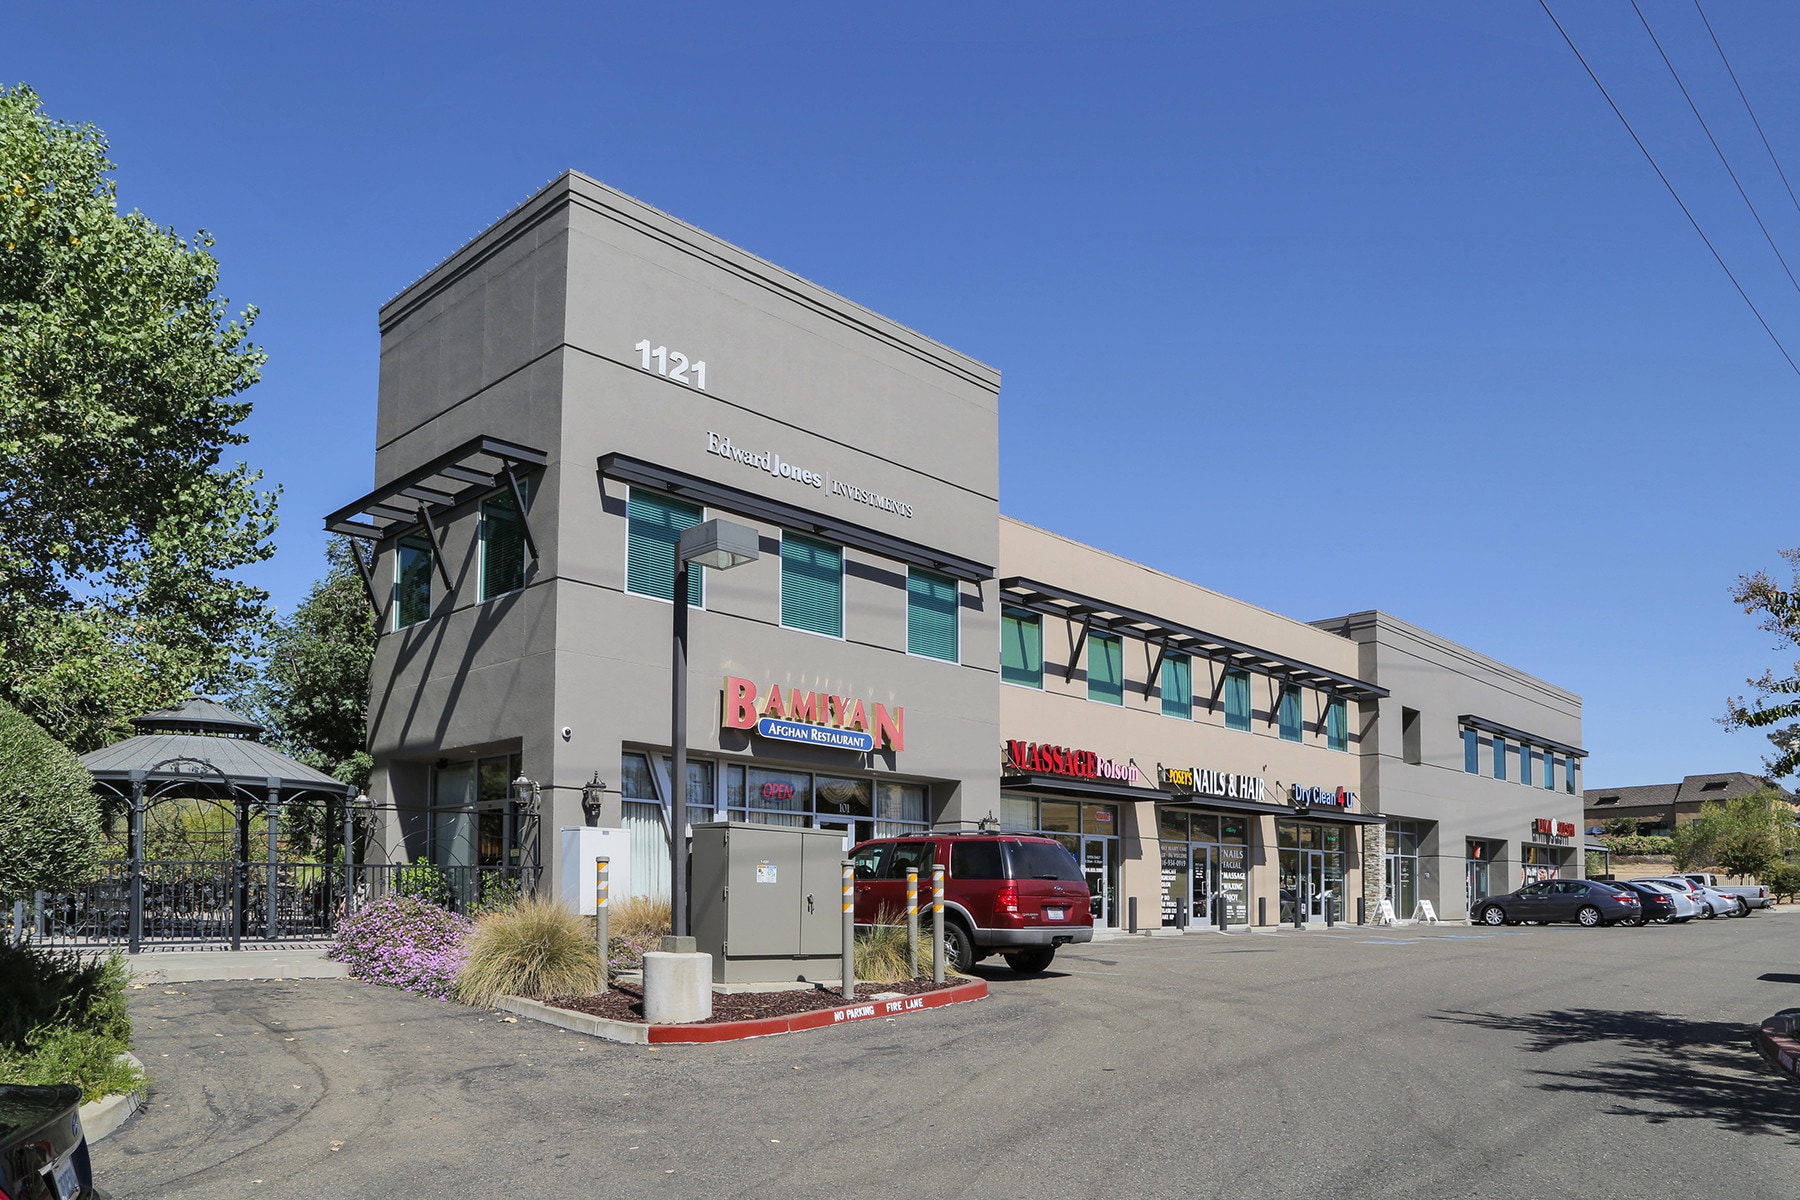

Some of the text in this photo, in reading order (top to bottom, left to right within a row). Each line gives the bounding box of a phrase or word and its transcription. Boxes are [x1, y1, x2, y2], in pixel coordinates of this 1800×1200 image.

[635, 339, 706, 391] 1121
[832, 480, 913, 518] INVESTMENTS
[724, 676, 904, 752] BAMIYAN
[768, 722, 865, 748] AFGHAN RESTAURANT
[1008, 740, 1139, 782] MASSAGE Folsom
[762, 781, 794, 800] OPEN
[1169, 767, 1265, 801] POSEY'S NAILS & HAIR
[1295, 783, 1354, 808] Dry Clean 4 U
[838, 803, 850, 814] 101
[1223, 849, 1244, 859] NAILS
[1223, 861, 1242, 869] FACIAL
[1223, 872, 1246, 880] MASSAGE
[1223, 882, 1243, 891] WAXING
[834, 998, 924, 1022] NO PARKING FIRE LANE
